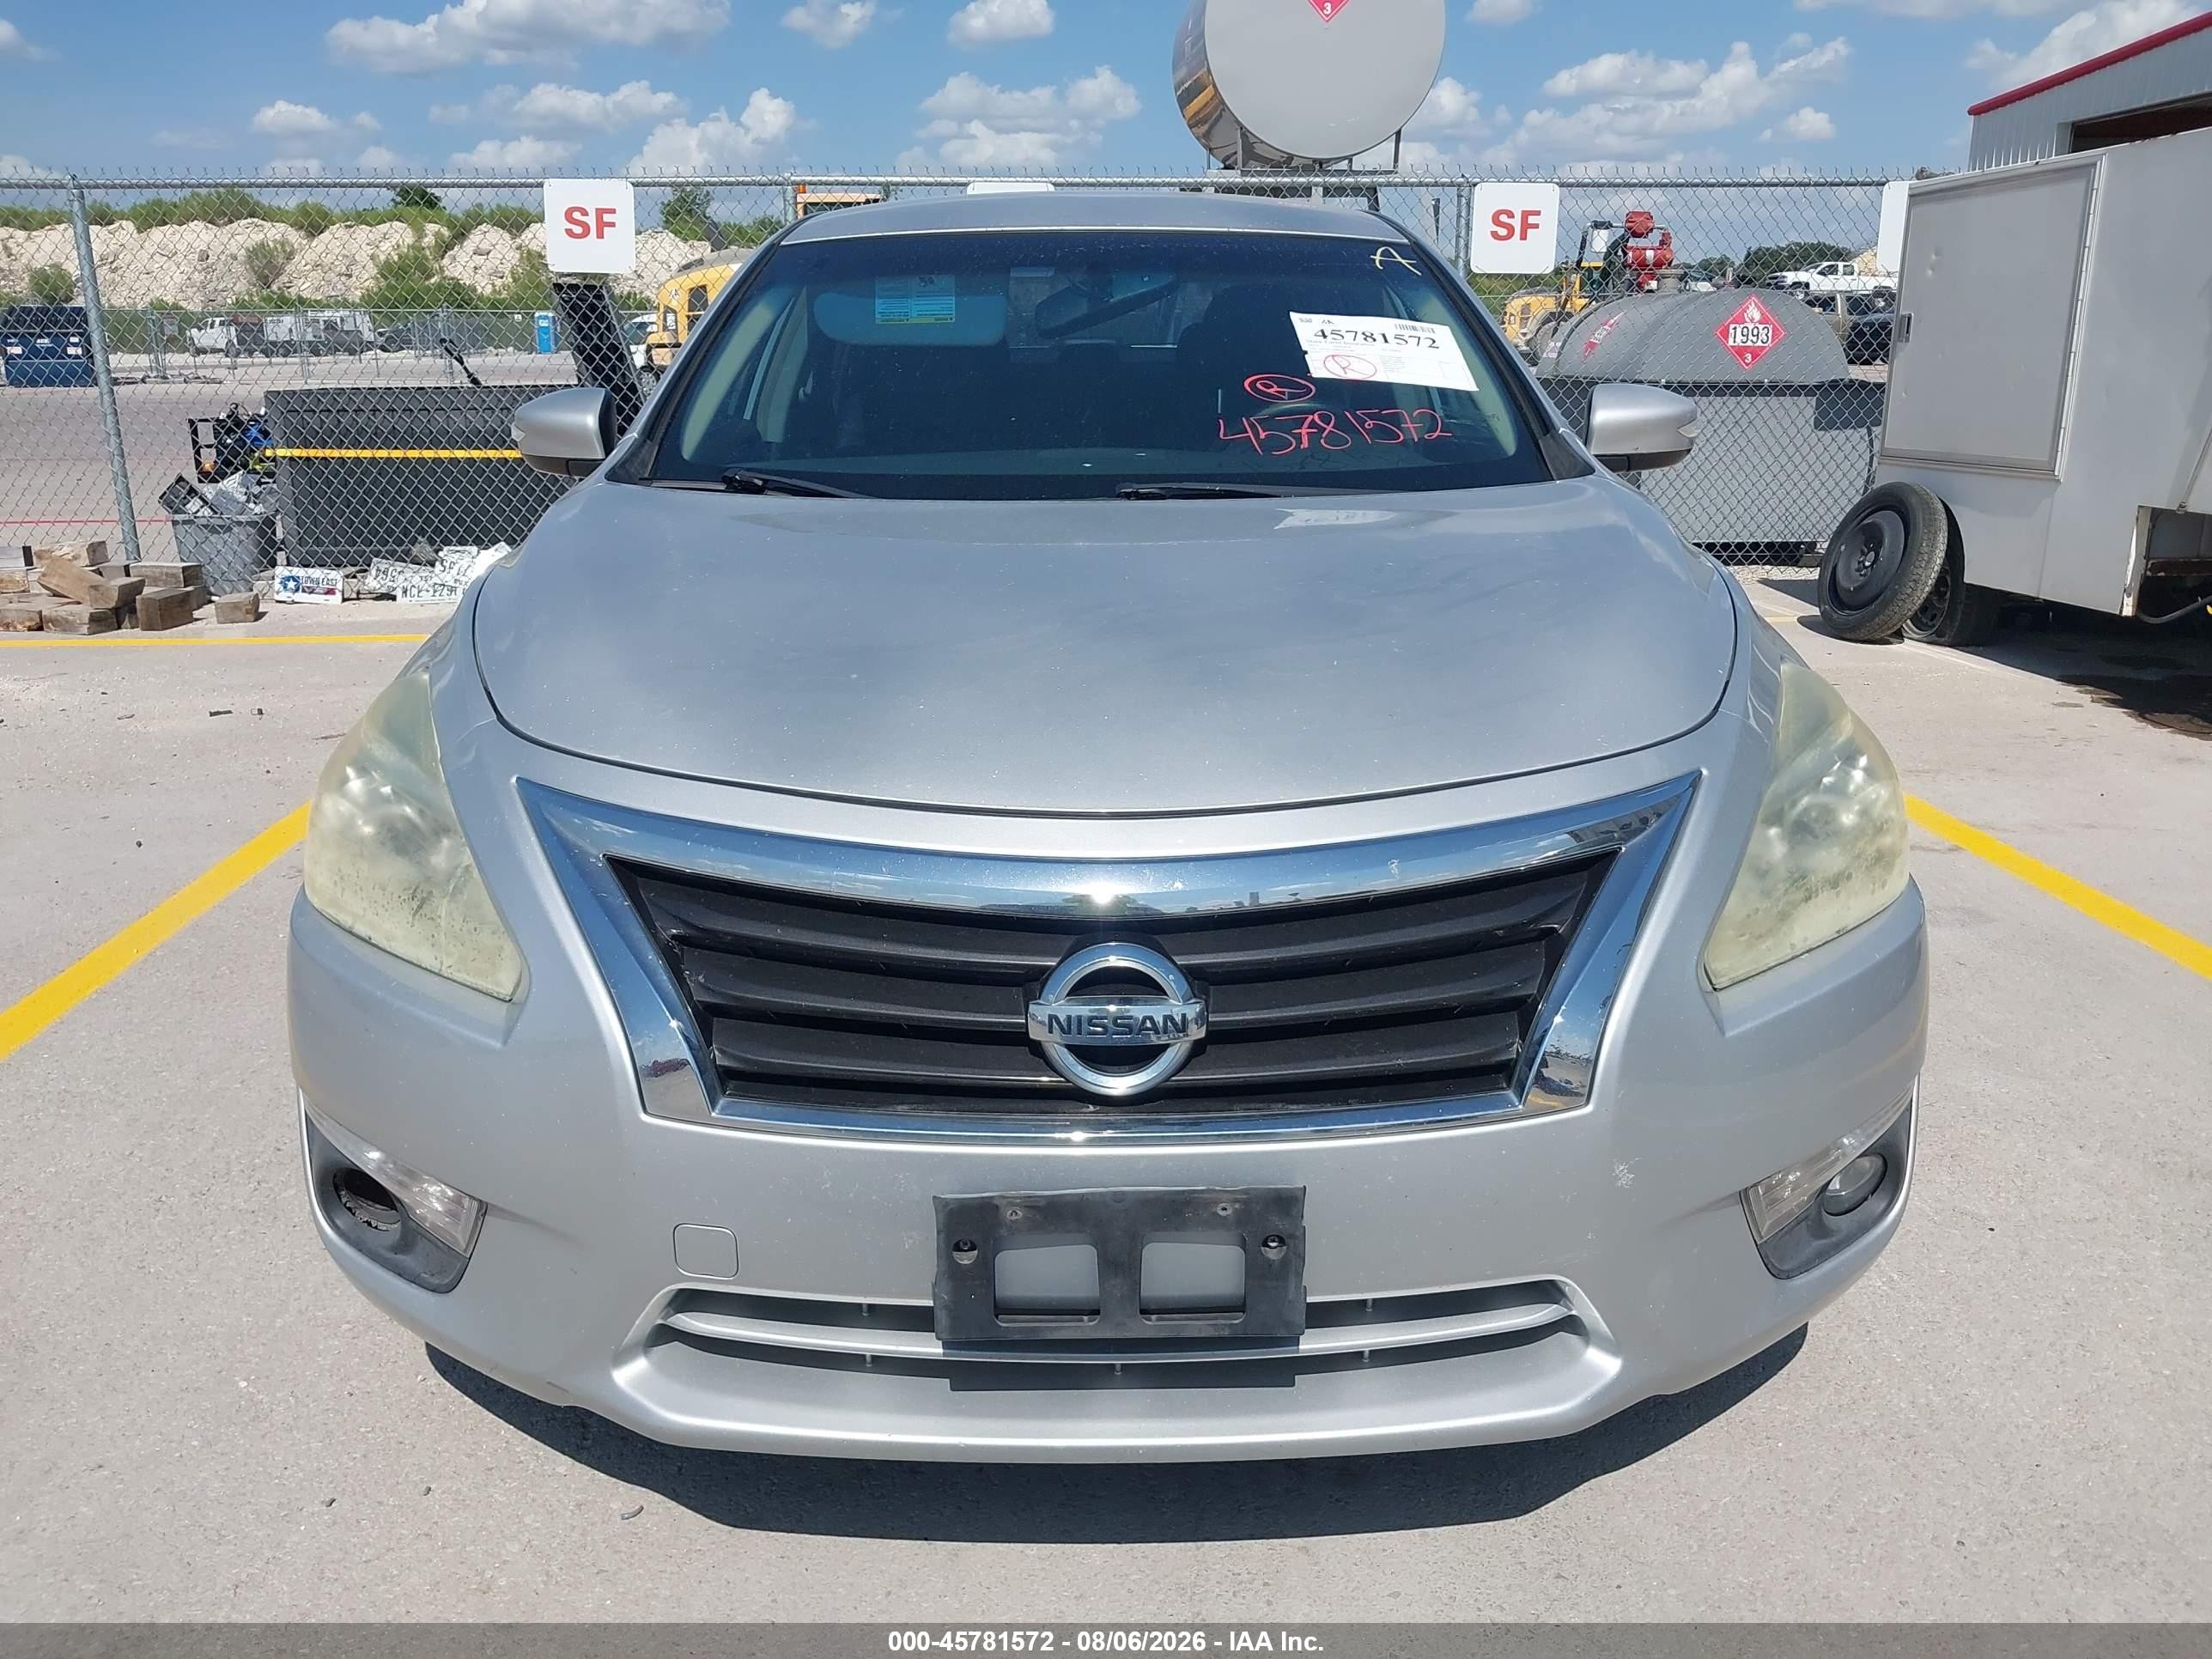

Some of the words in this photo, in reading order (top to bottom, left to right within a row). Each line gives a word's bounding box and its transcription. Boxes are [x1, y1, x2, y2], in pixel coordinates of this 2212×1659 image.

[1323, 2, 1333, 14] 3
[564, 206, 617, 240] SF
[1490, 209, 1542, 241] SF
[1314, 328, 1440, 349] 45781572
[1731, 325, 1770, 344] 1993
[1744, 352, 1753, 363] 3
[1218, 408, 1453, 456] 45781572
[301, 575, 320, 586] TOWN
[1047, 1013, 1188, 1036] NISSAN
